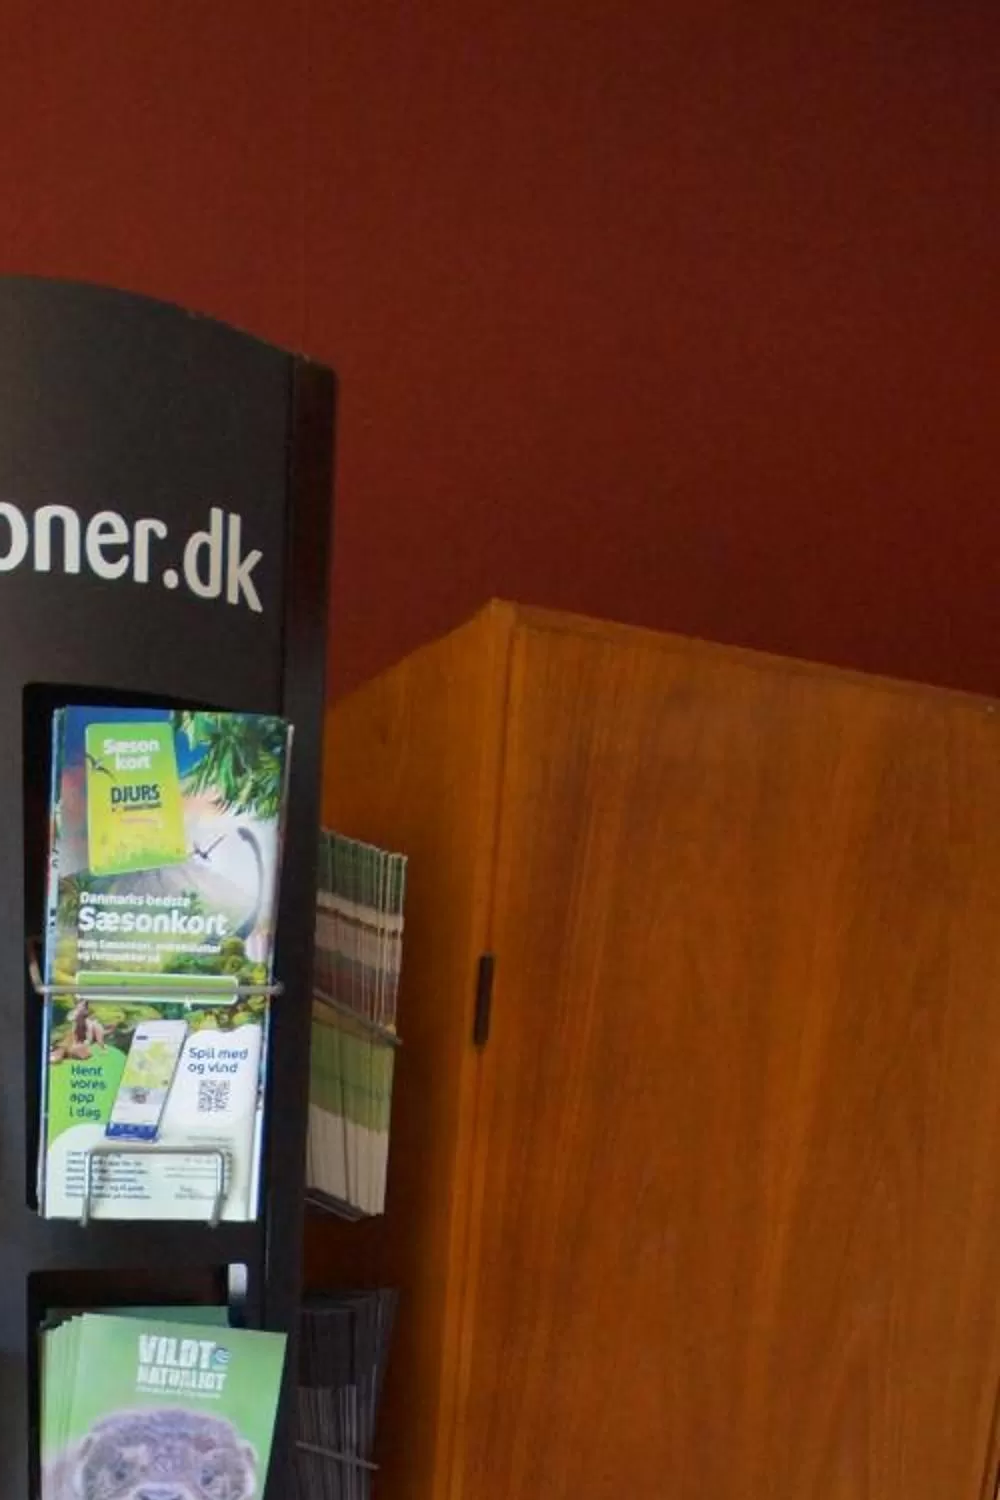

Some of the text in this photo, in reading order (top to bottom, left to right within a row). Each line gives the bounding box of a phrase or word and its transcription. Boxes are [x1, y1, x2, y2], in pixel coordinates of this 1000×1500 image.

[110, 783, 161, 804] DJURS
[77, 905, 228, 937] Sæsonkort
[189, 1047, 215, 1060] Spil
[187, 1063, 205, 1075] og
[138, 1334, 217, 1369] VILDT
